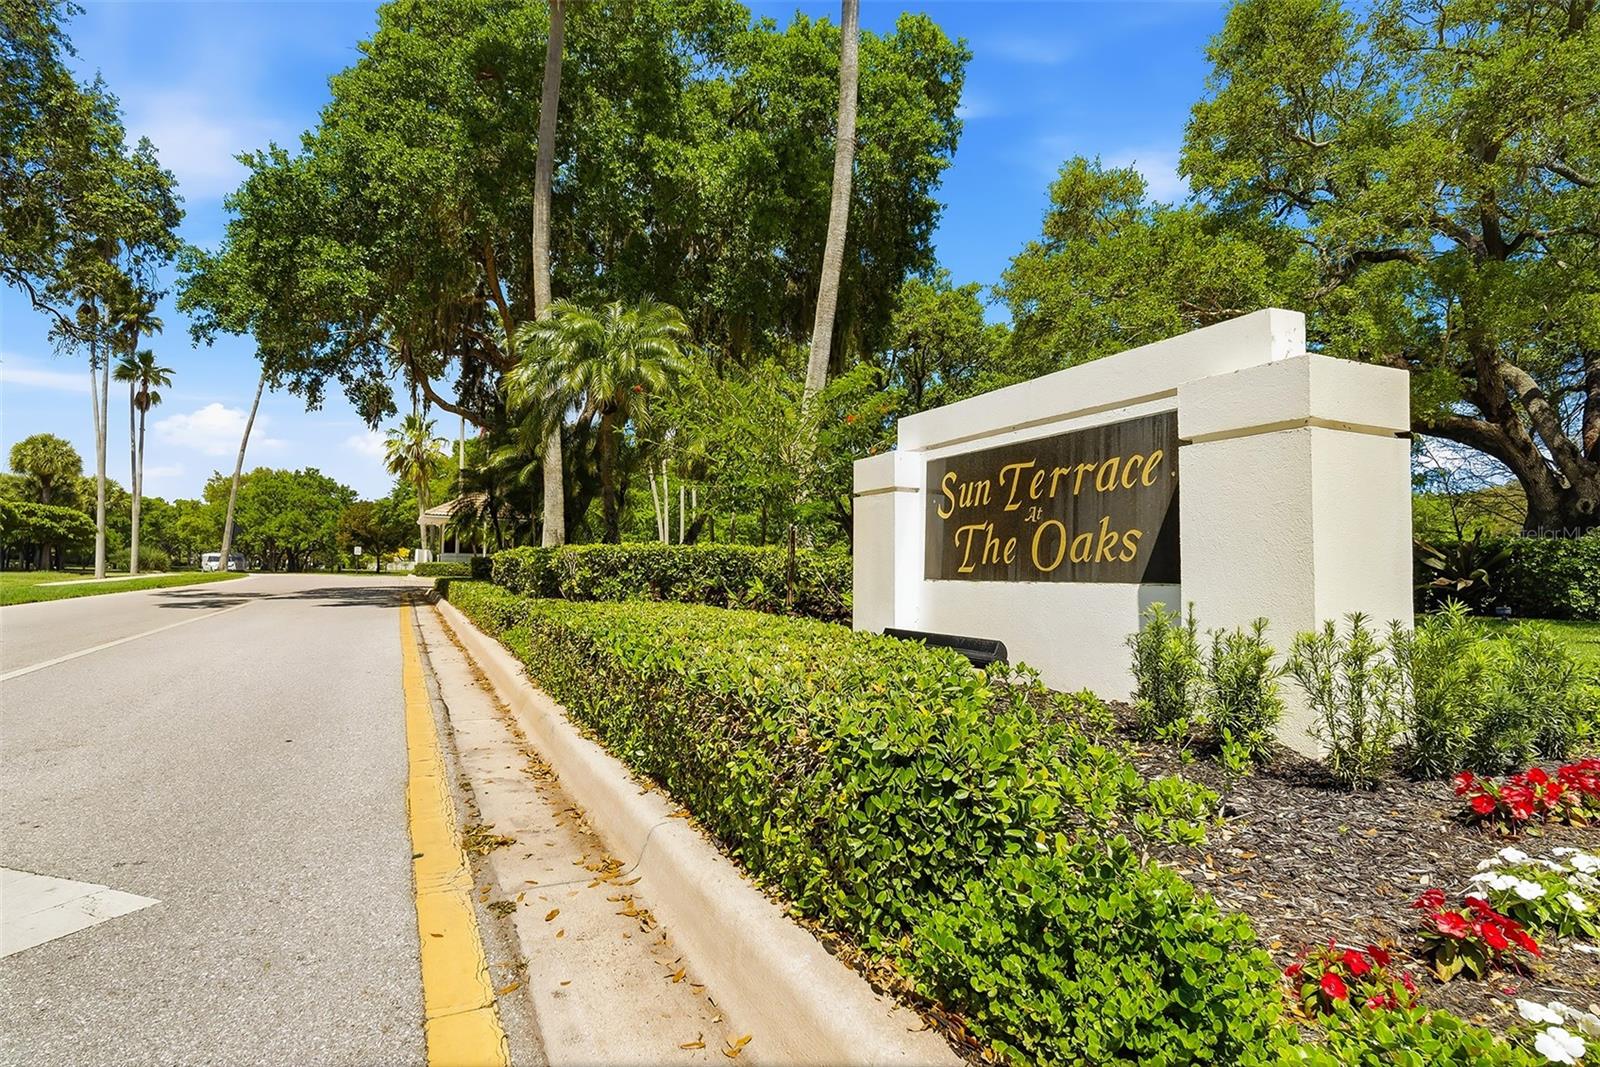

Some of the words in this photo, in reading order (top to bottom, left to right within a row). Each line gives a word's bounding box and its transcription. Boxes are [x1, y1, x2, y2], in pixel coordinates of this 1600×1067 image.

[937, 471, 991, 519] Sun
[999, 449, 1163, 511] Terrace
[1025, 506, 1043, 522] At
[955, 520, 1016, 573] The
[1032, 516, 1143, 571] Oaks
